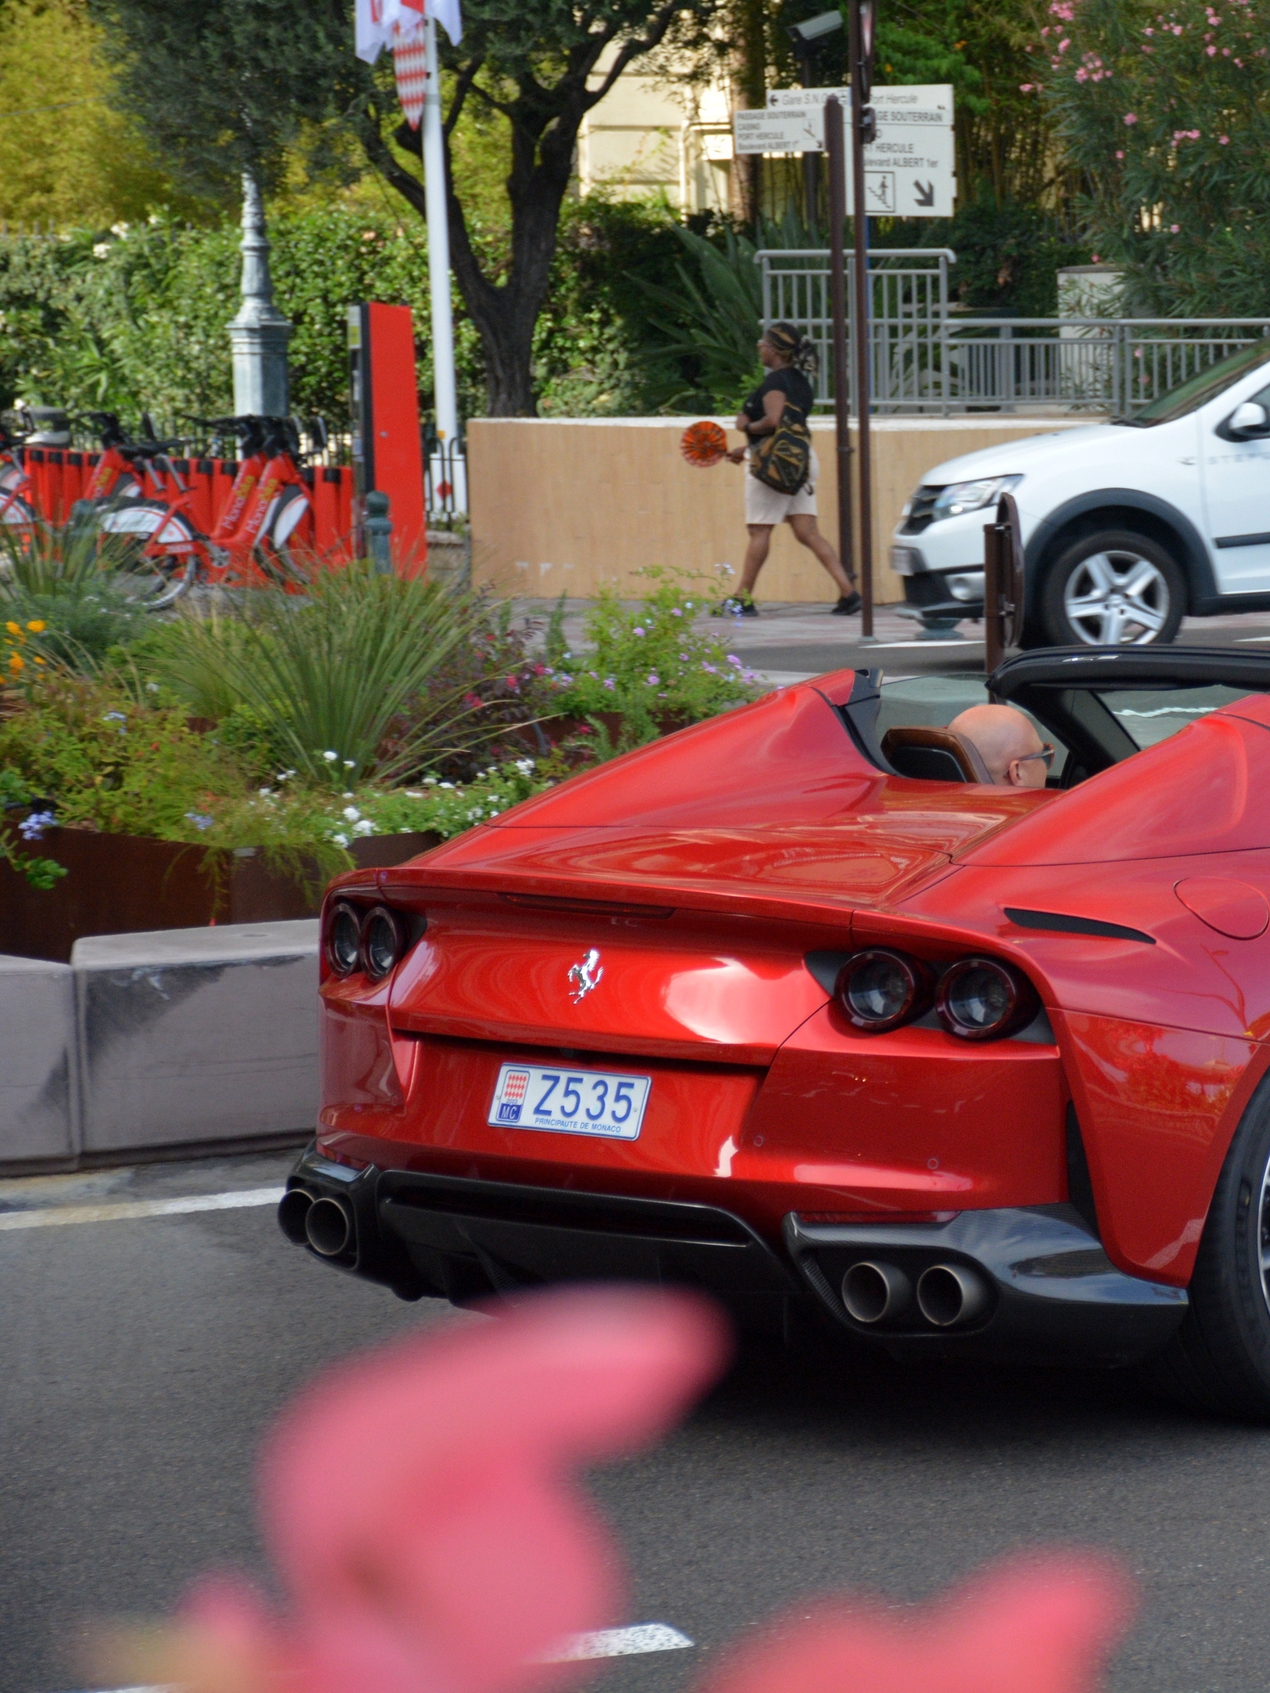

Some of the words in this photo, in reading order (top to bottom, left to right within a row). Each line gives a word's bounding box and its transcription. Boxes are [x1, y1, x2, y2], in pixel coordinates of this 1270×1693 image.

[782, 94, 802, 105] Gare
[871, 94, 884, 104] ort
[885, 93, 918, 104] Hercule
[737, 112, 765, 120] PASSAGE
[767, 111, 806, 119] SOUTERRAIN
[890, 110, 943, 122] SOUTERRAIN
[737, 123, 761, 131] CASINO
[738, 132, 754, 140] PORT
[755, 132, 784, 140] HERCULE
[738, 142, 766, 151] Boulevard
[767, 141, 791, 150] ALBERT
[875, 143, 914, 154] HERCULE
[892, 157, 924, 168] ALBERT
[925, 158, 939, 168] 1er
[533, 1074, 635, 1123] Z535
[501, 1105, 517, 1119] MC
[534, 1117, 578, 1129] PRINCIPAUTE
[579, 1121, 589, 1130] DE
[591, 1122, 621, 1133] MONACO
